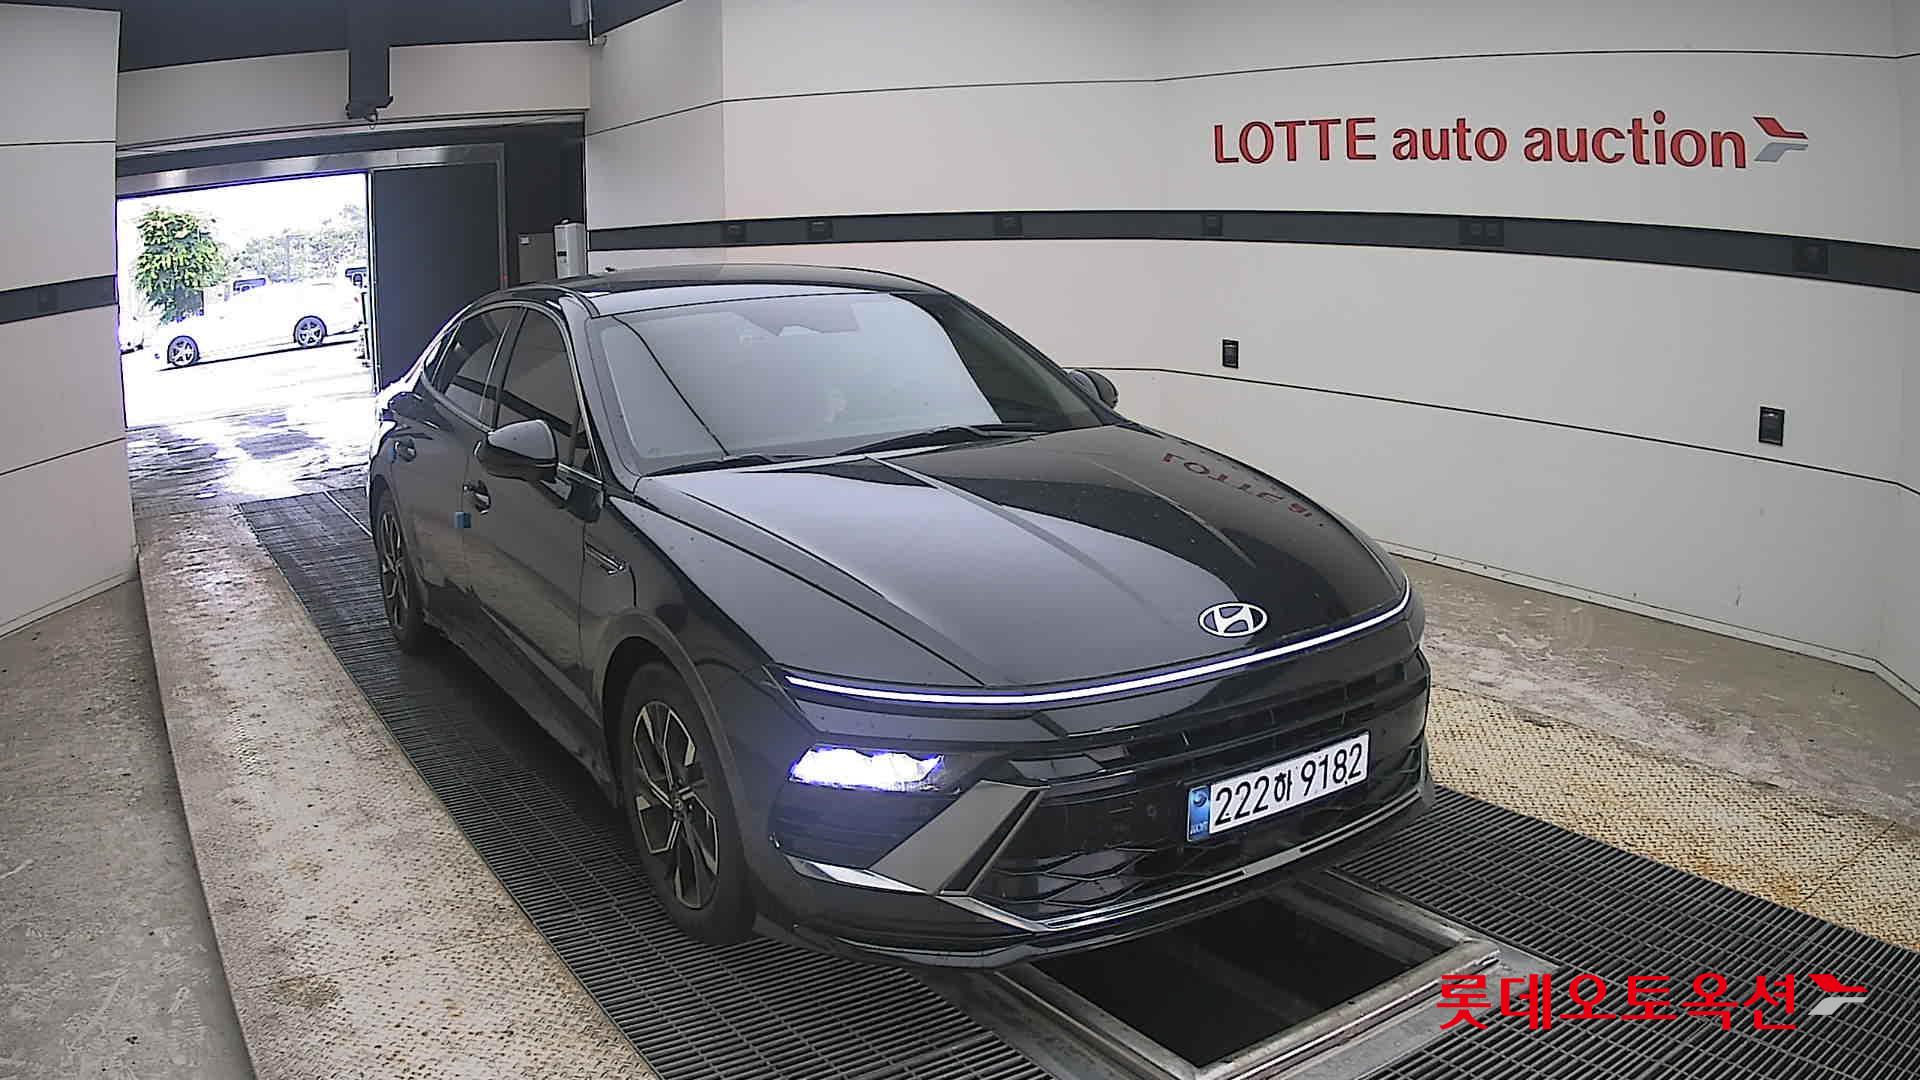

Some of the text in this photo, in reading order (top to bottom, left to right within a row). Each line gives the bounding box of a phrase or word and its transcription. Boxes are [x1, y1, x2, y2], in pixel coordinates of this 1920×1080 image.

[1213, 110, 1747, 168] LOTTE auto auction
[1214, 743, 1363, 826] 222하 9182
